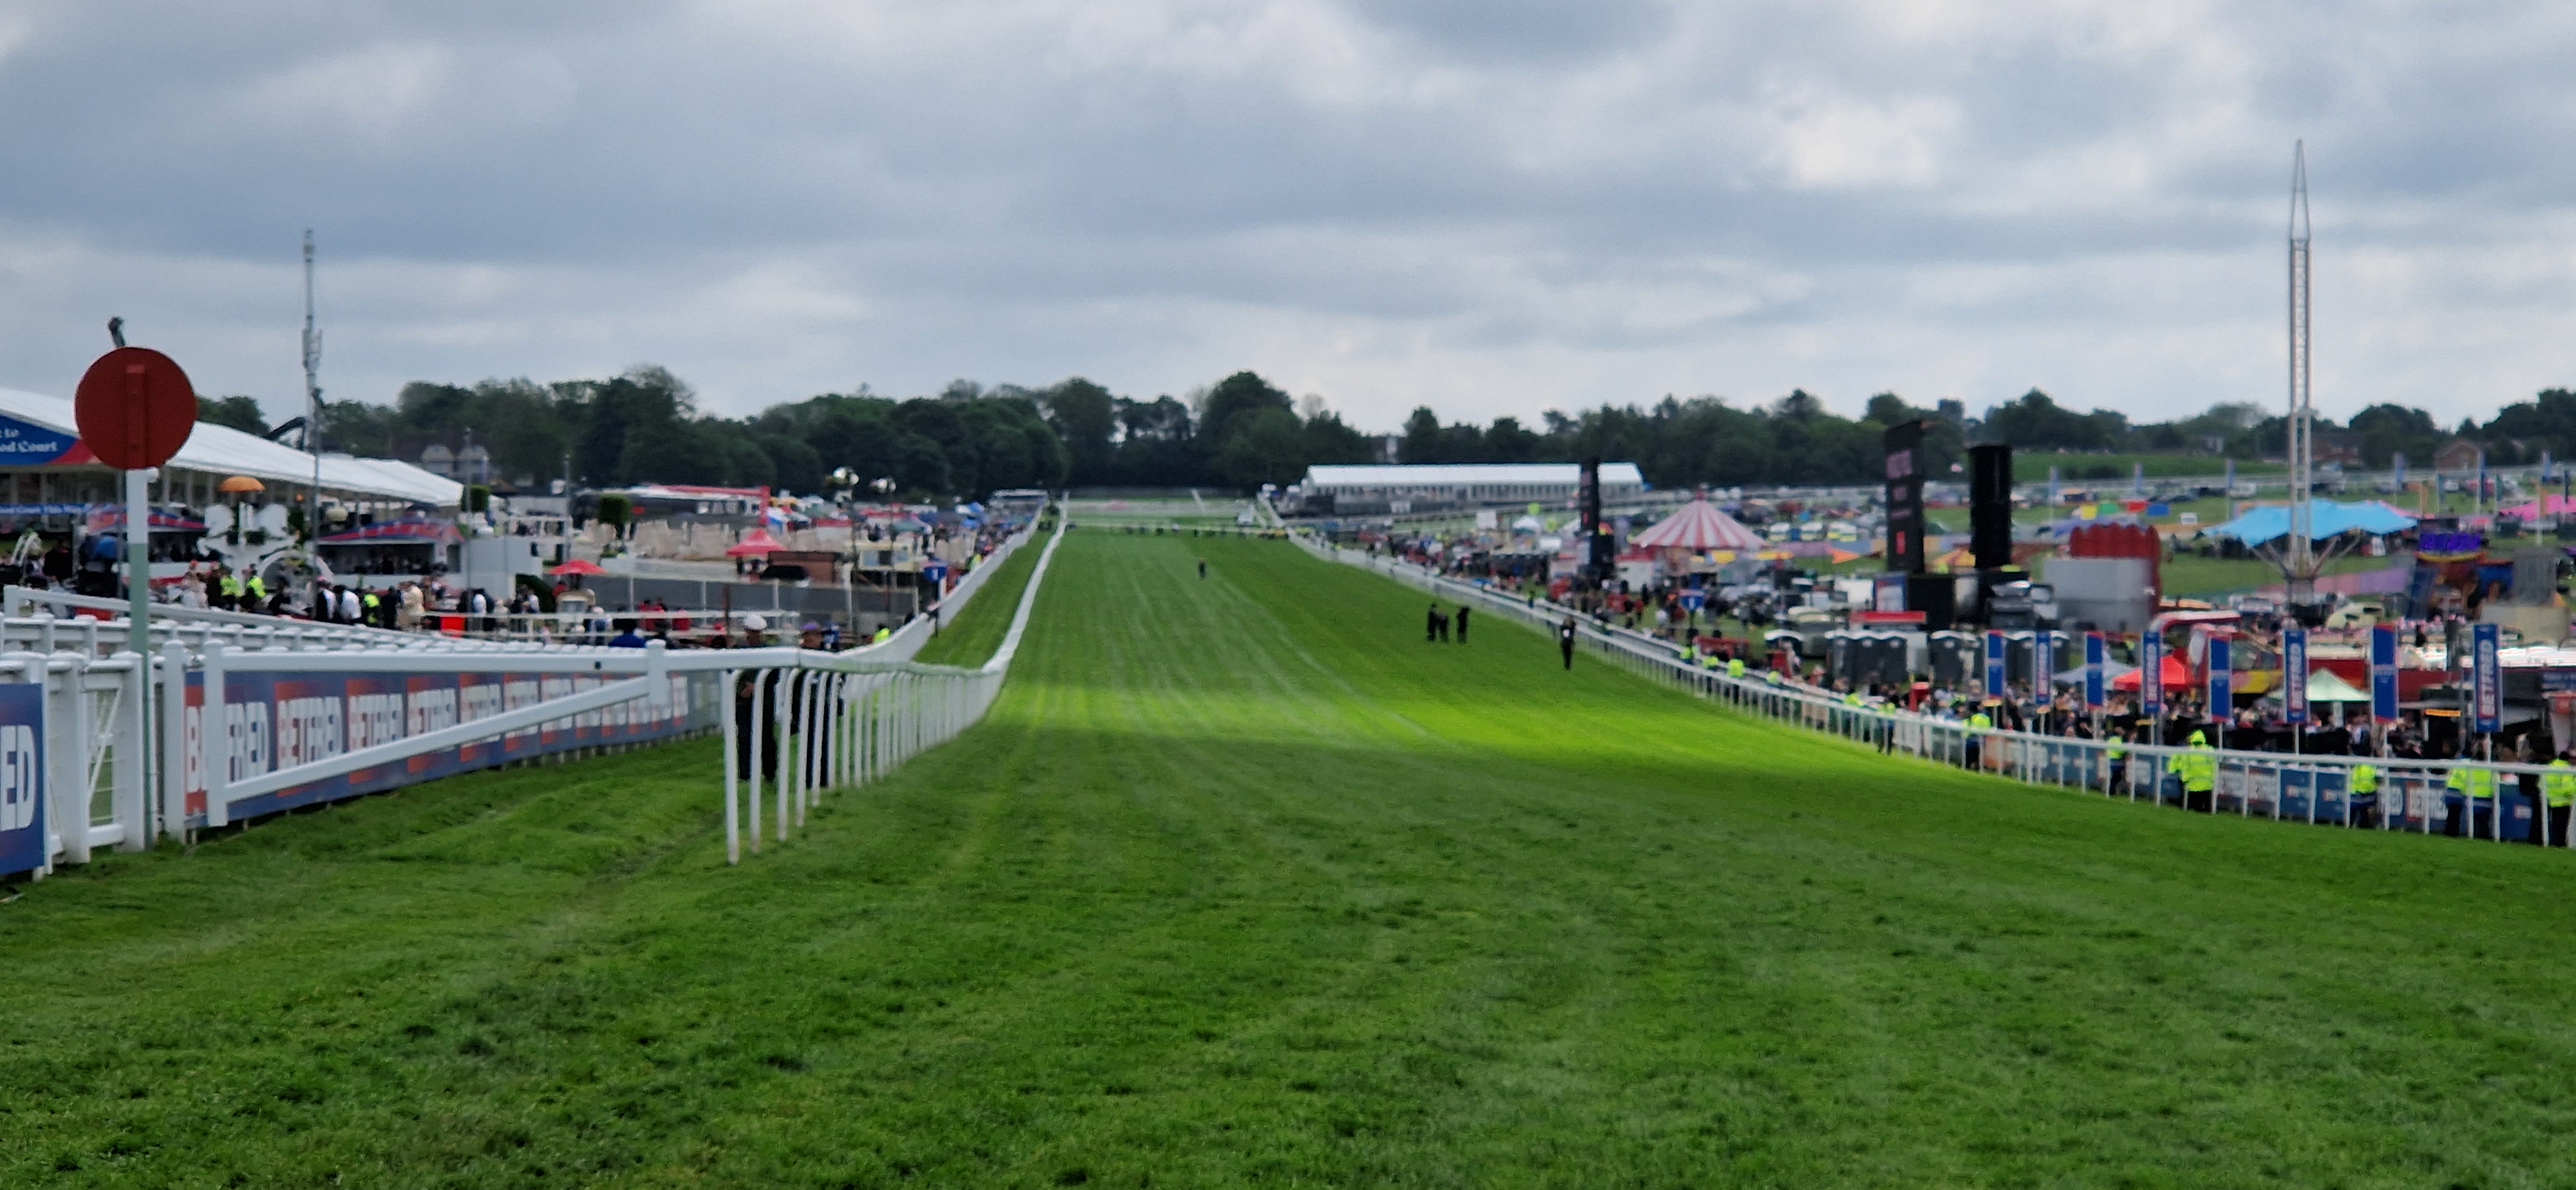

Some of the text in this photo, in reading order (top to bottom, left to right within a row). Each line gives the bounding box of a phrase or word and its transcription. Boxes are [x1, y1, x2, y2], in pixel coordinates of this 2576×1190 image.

[17, 440, 58, 453] Court
[2289, 643, 2303, 709] BETFRED
[2481, 639, 2495, 715] BETFRED
[277, 696, 342, 770] BETFRED
